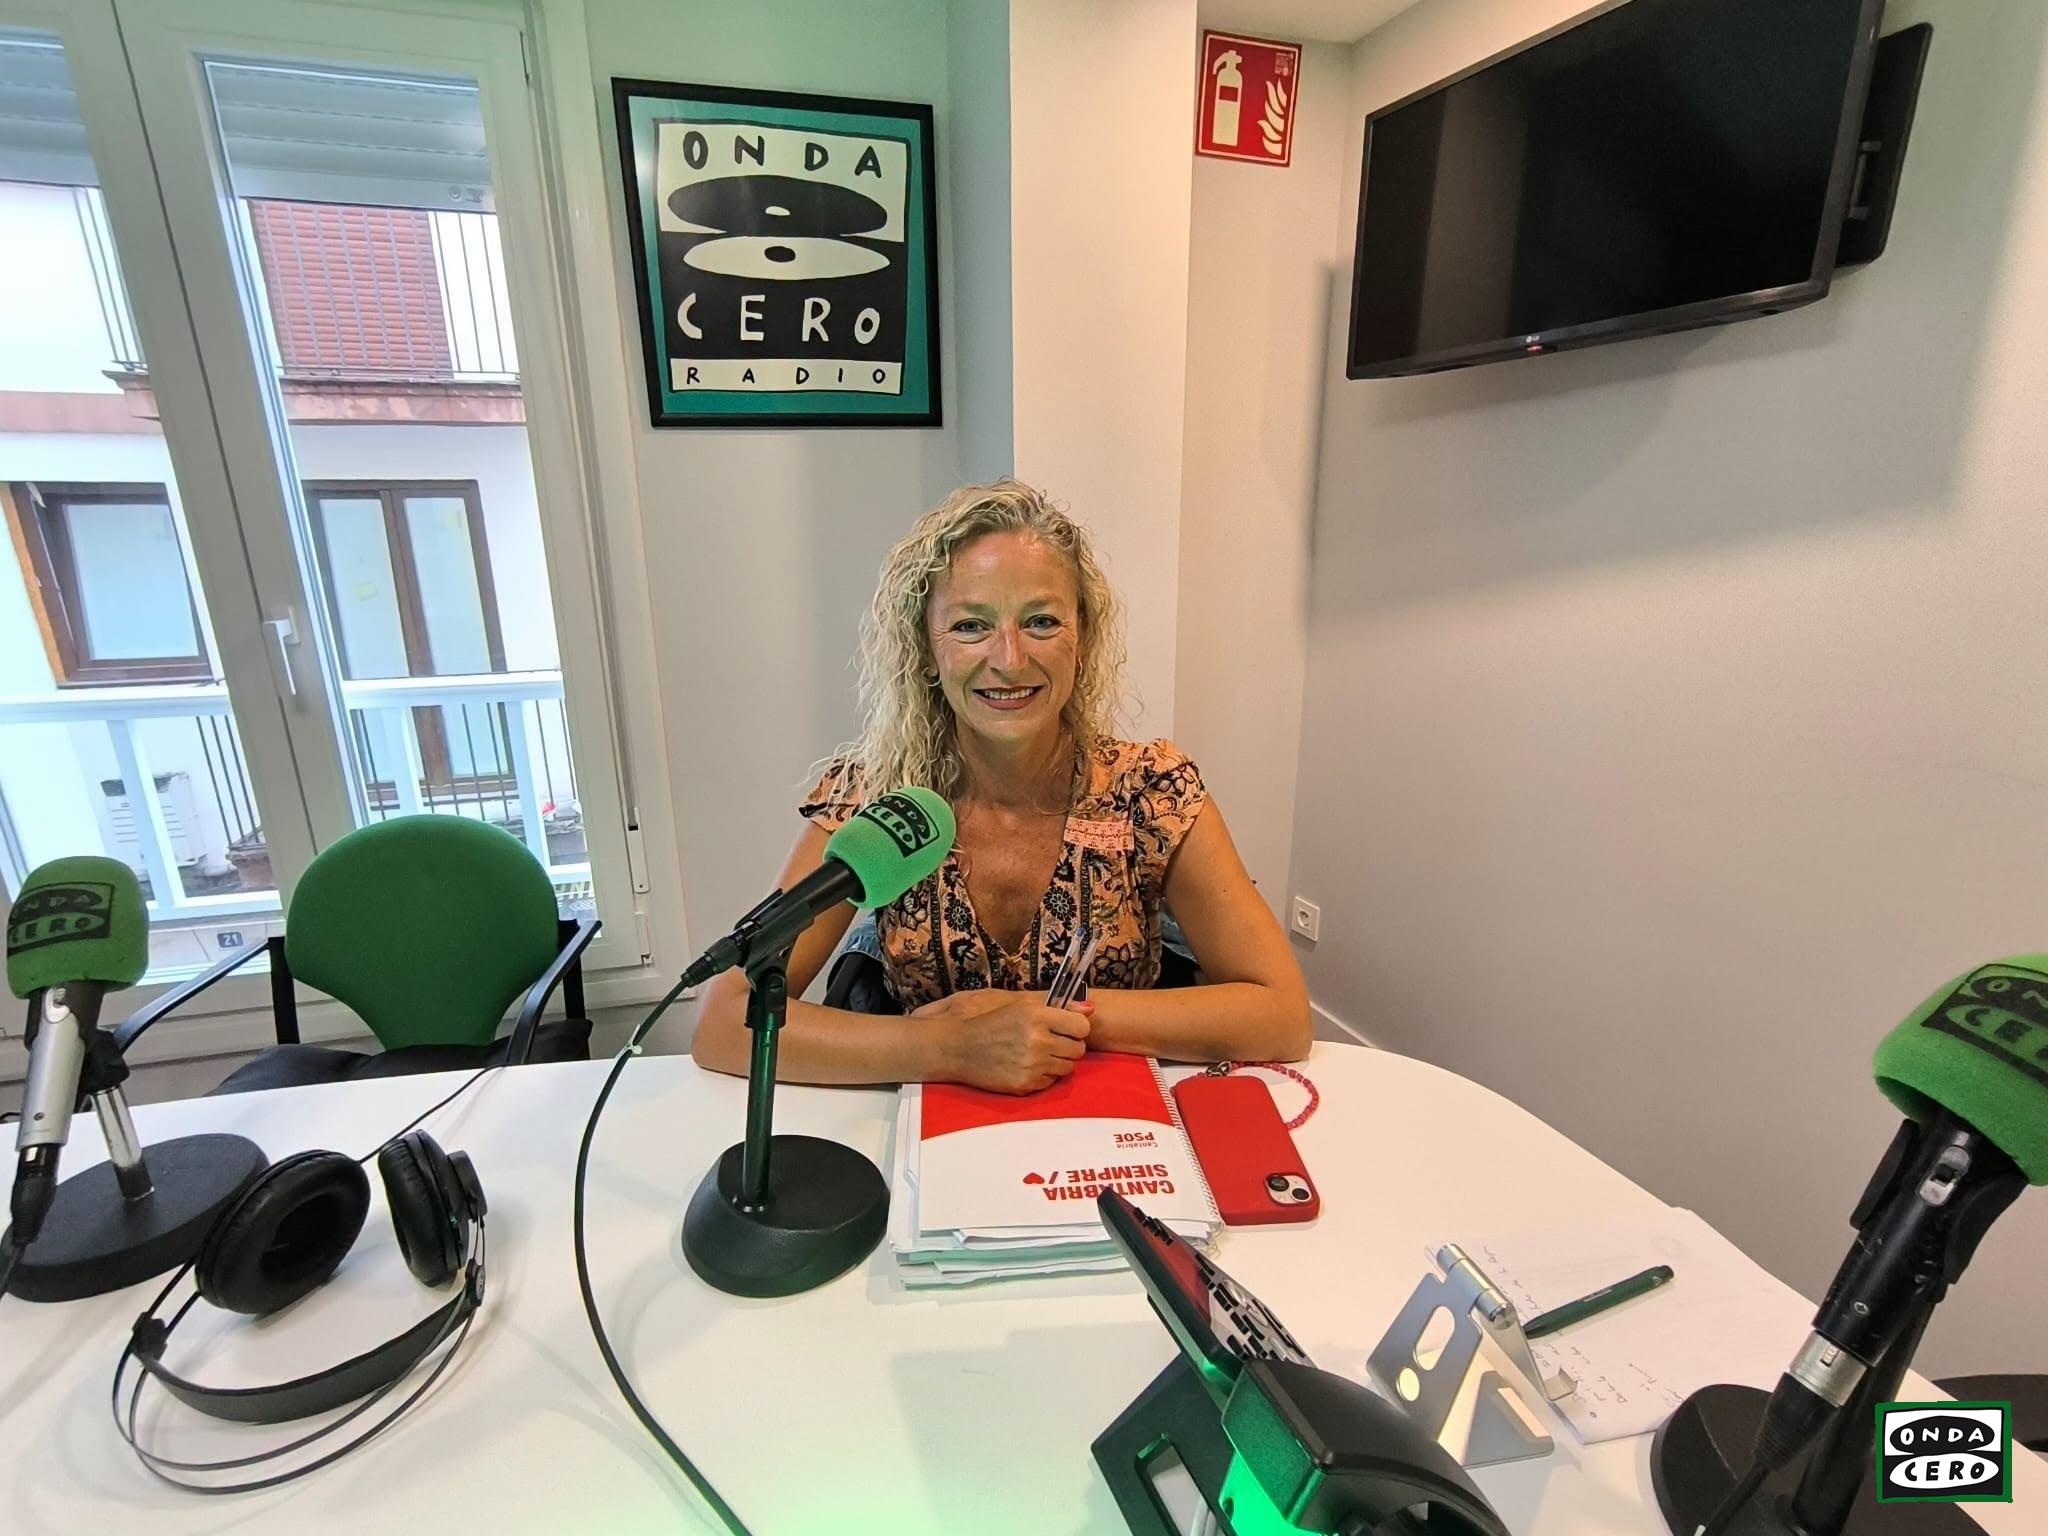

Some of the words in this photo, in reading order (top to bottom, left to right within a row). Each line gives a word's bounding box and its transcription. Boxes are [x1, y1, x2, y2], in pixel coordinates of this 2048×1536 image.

[682, 131, 882, 178] ONDA
[677, 292, 881, 345] CERO
[686, 367, 886, 385] RADIO
[871, 806, 913, 843] CERO
[883, 796, 926, 834] ONDA
[1113, 1131, 1155, 1142] PSOE
[1116, 1142, 1158, 1150] Cantabria
[1066, 1164, 1169, 1183] SIEMPRE
